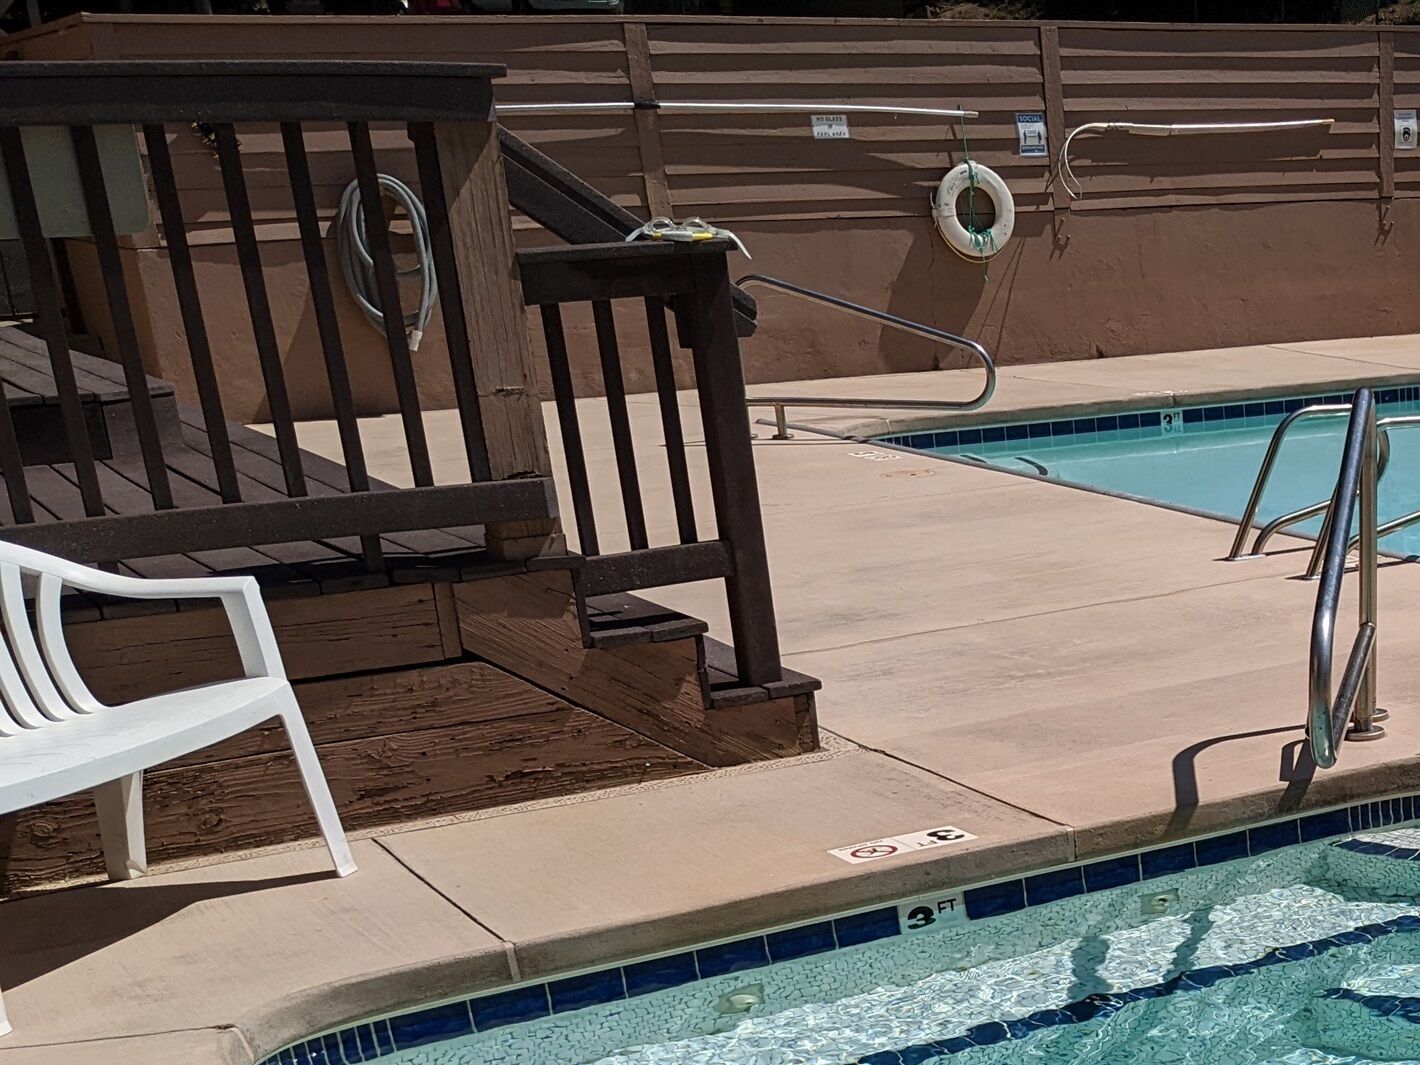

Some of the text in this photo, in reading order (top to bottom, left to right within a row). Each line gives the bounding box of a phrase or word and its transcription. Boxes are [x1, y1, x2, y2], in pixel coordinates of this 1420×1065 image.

[926, 828, 966, 841] 3
[907, 898, 957, 930] 3 FT
